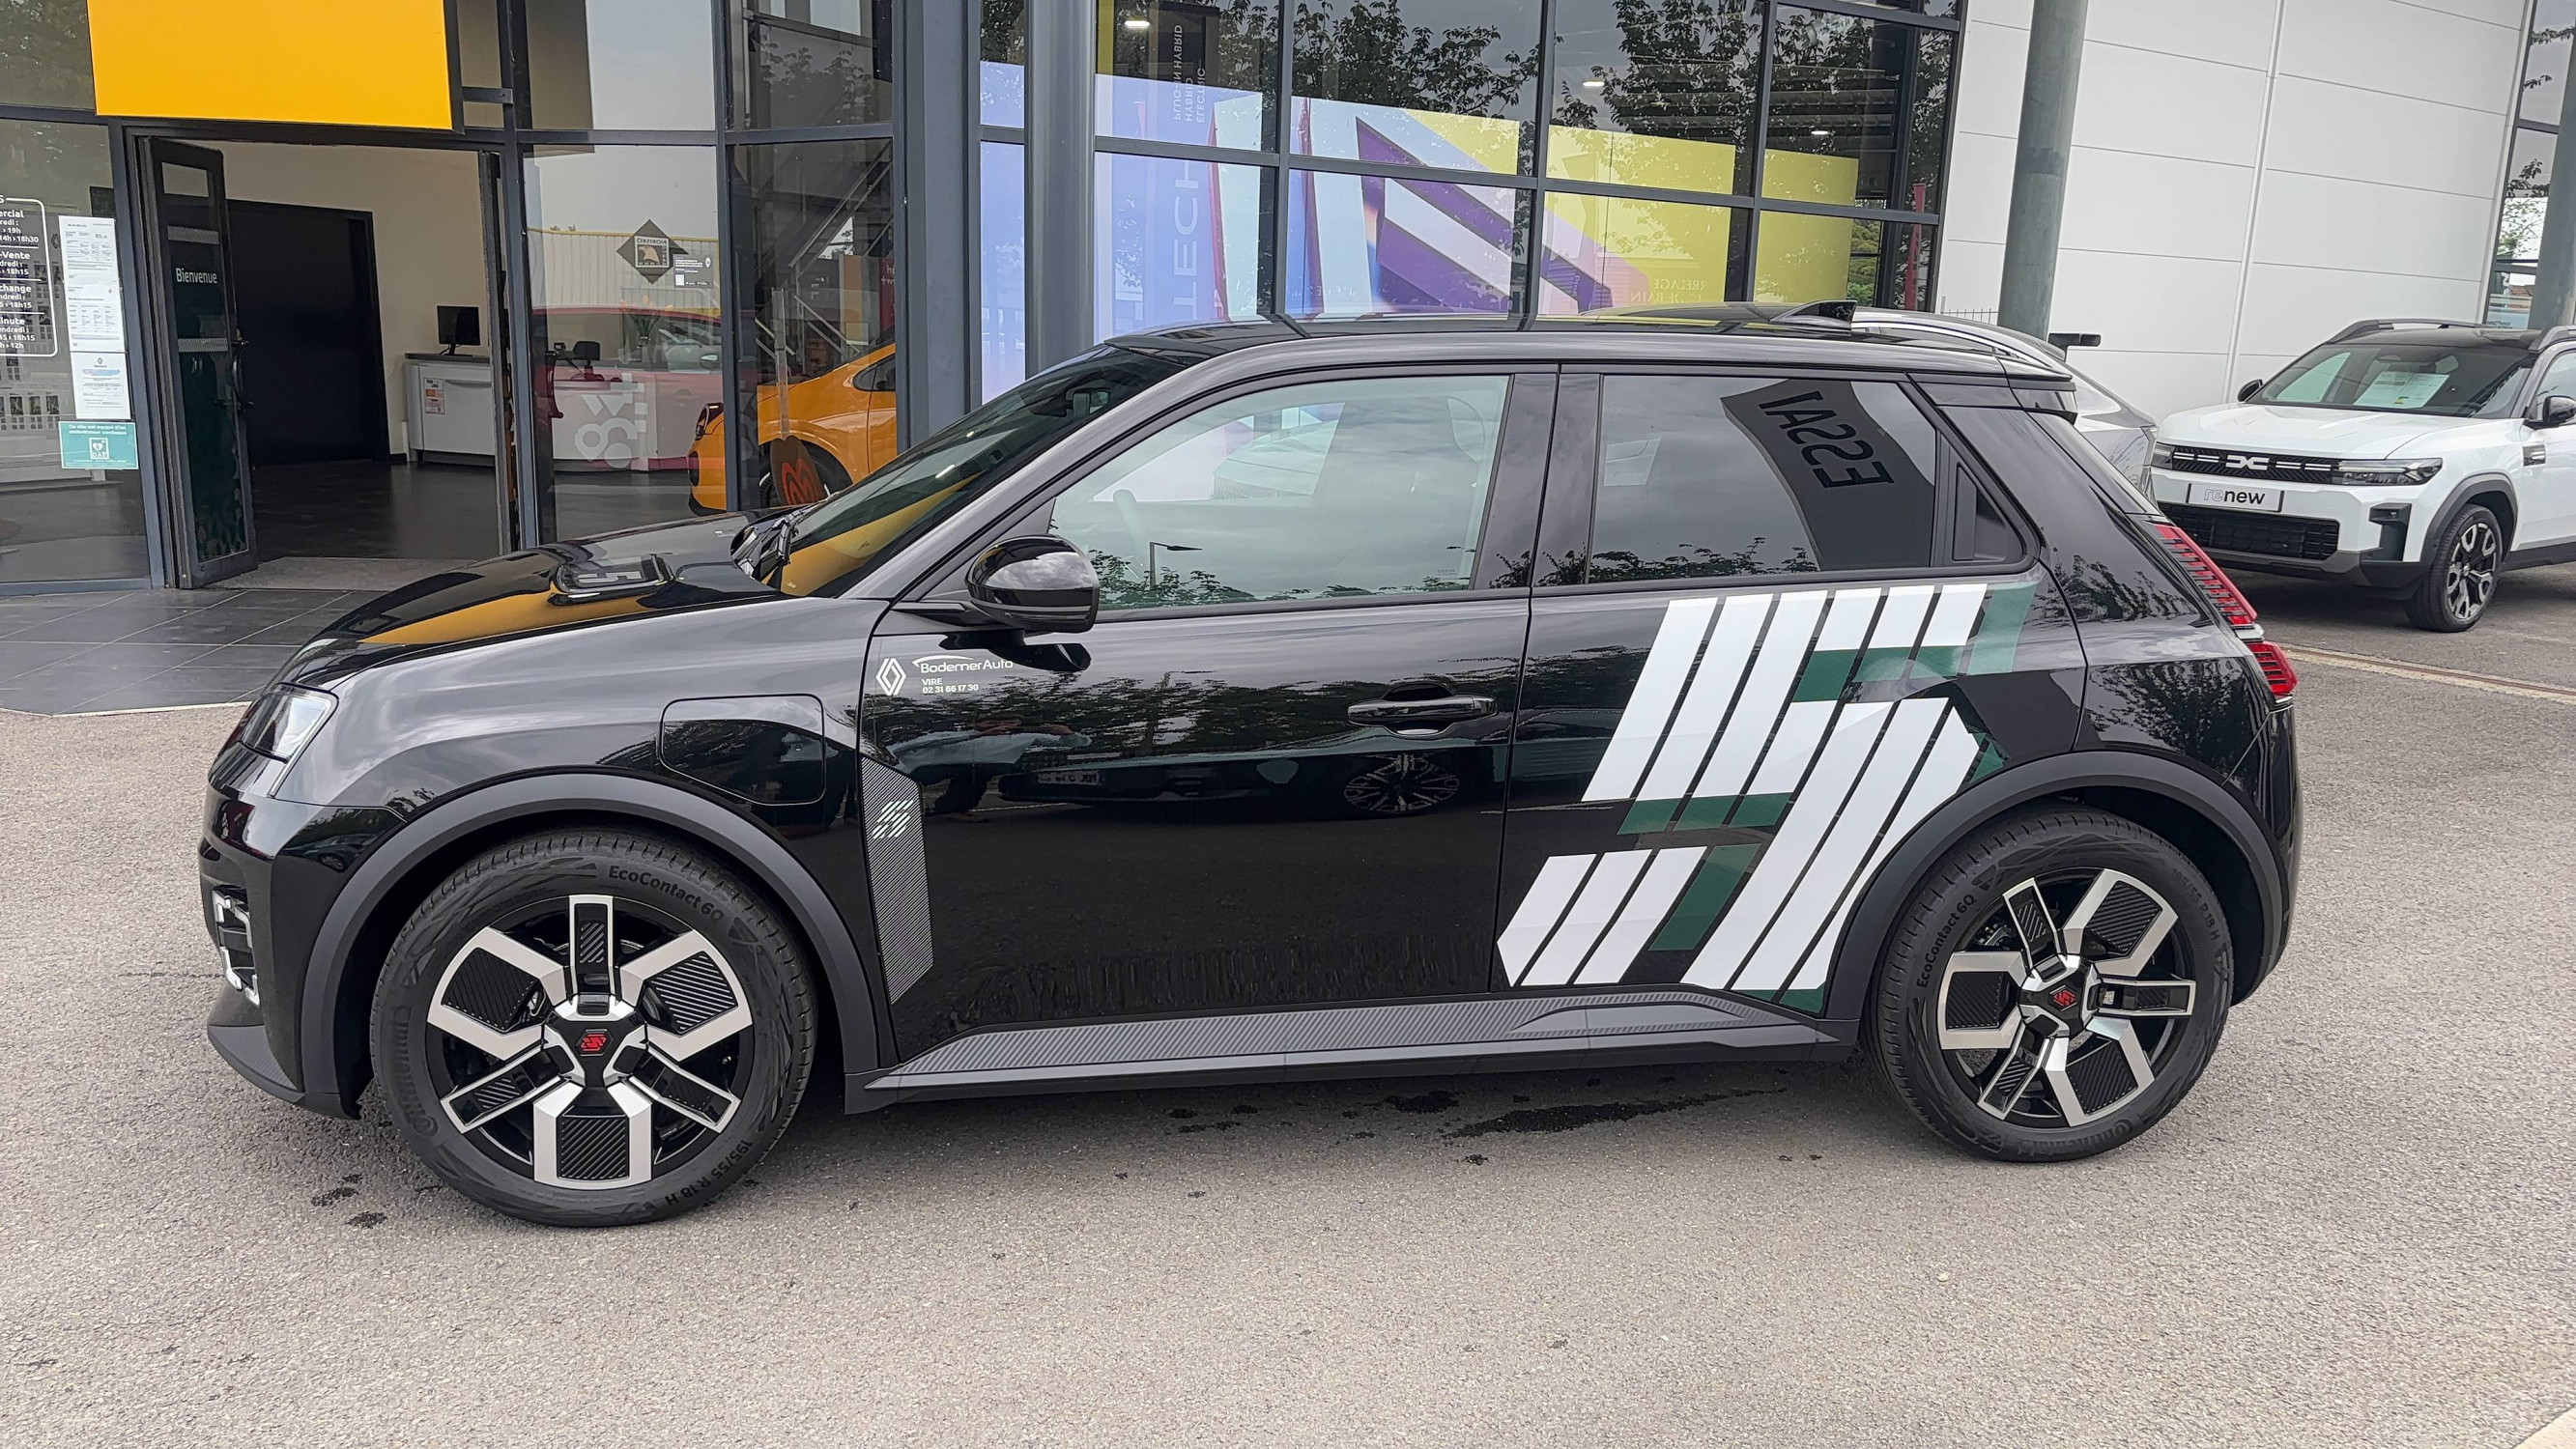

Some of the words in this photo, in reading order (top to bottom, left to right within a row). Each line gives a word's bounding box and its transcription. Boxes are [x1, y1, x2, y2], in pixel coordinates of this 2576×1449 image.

[175, 267, 218, 284] Bienvenue
[2204, 489, 2266, 504] renew
[922, 677, 943, 686] VIRE
[609, 865, 701, 908] EcoContact
[1916, 913, 1961, 988] EcoContact
[710, 1139, 753, 1179] 195/55
